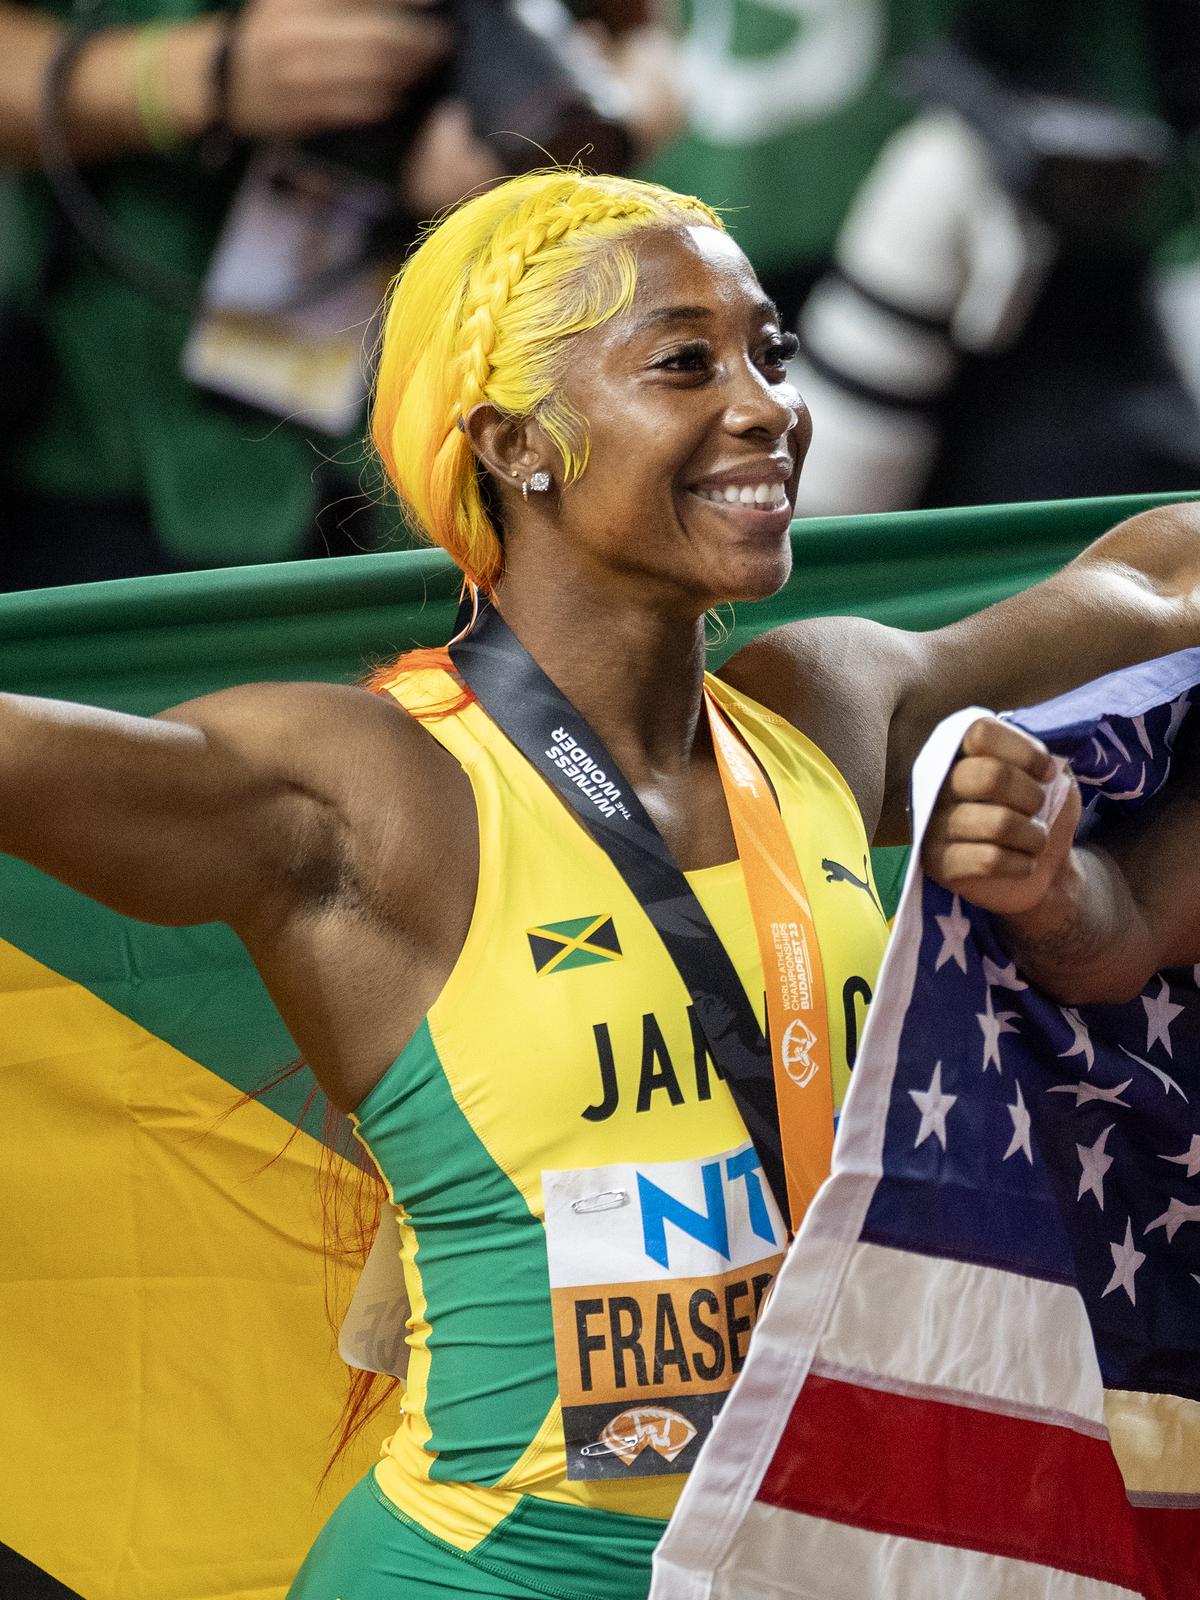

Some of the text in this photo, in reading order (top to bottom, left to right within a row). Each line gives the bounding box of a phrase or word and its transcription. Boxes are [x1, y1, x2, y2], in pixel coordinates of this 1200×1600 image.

[544, 745, 617, 818] WITNESS
[551, 726, 632, 820] THE WONDER
[770, 922, 791, 1011] WORLD ATHLETICS
[779, 922, 801, 1011] CHAMPIONSHIPS
[788, 922, 810, 1010] BUDAPEST 23
